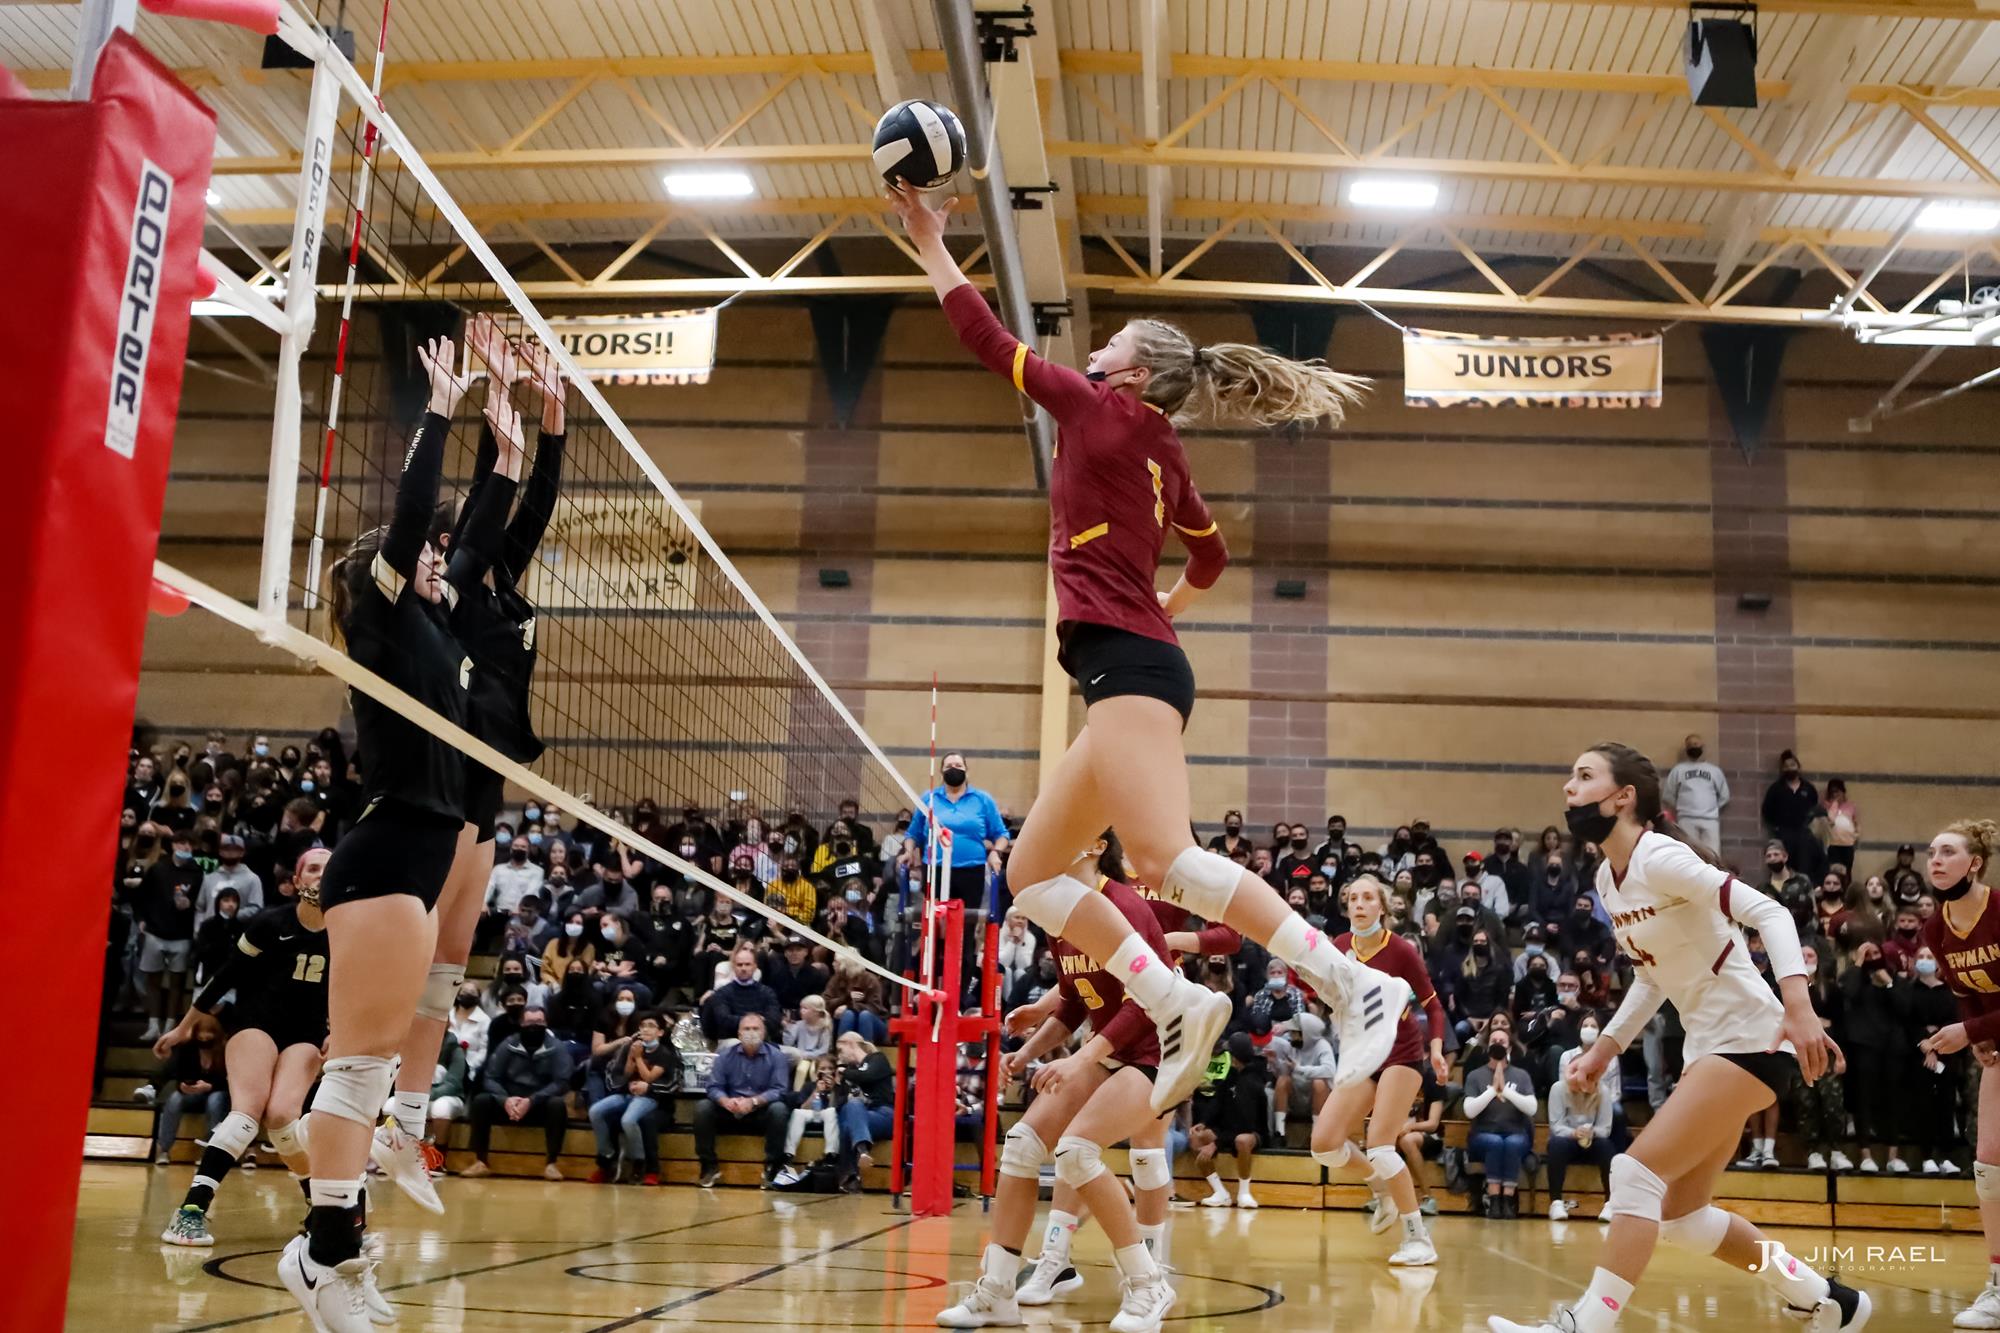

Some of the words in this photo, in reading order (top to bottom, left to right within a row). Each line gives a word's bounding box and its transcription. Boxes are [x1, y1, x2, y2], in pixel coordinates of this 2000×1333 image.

[114, 170, 168, 415] PORTER
[1454, 353, 1612, 378] JUNIORS
[292, 953, 326, 983] 12
[1073, 978, 1105, 1010] 9
